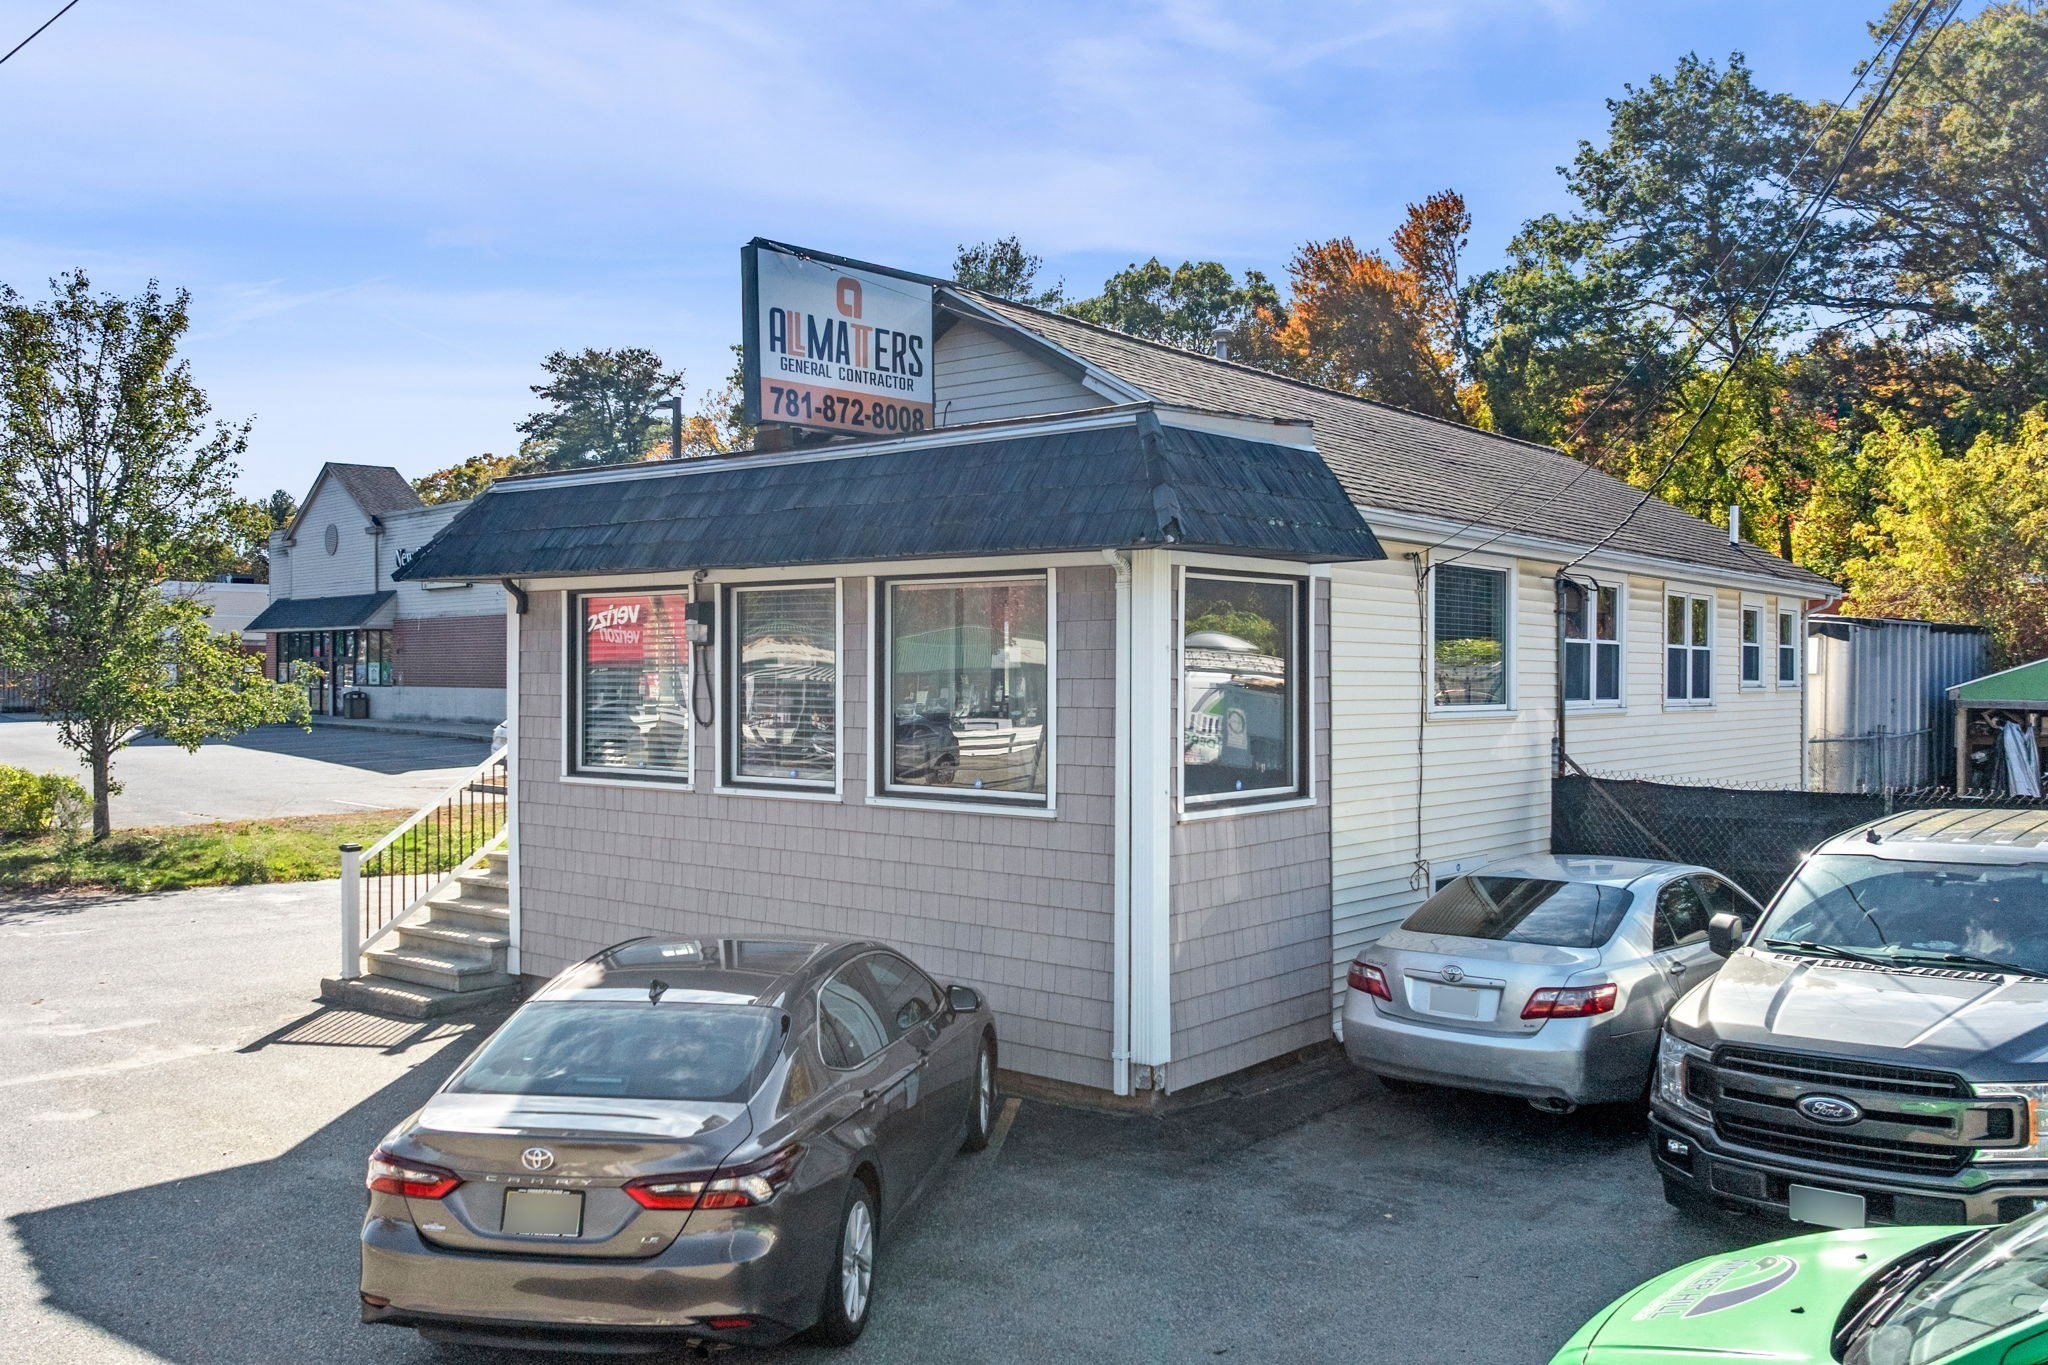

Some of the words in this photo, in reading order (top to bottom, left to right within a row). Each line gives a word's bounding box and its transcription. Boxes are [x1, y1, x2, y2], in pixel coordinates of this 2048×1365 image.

[780, 356, 832, 379] GENERAL
[838, 366, 914, 392] CONTRACTOR
[770, 386, 925, 432] 781-872-8008
[1811, 1101, 1844, 1117] Ford
[485, 1175, 593, 1186] CAMRY
[1650, 1292, 1704, 1320] HILL
